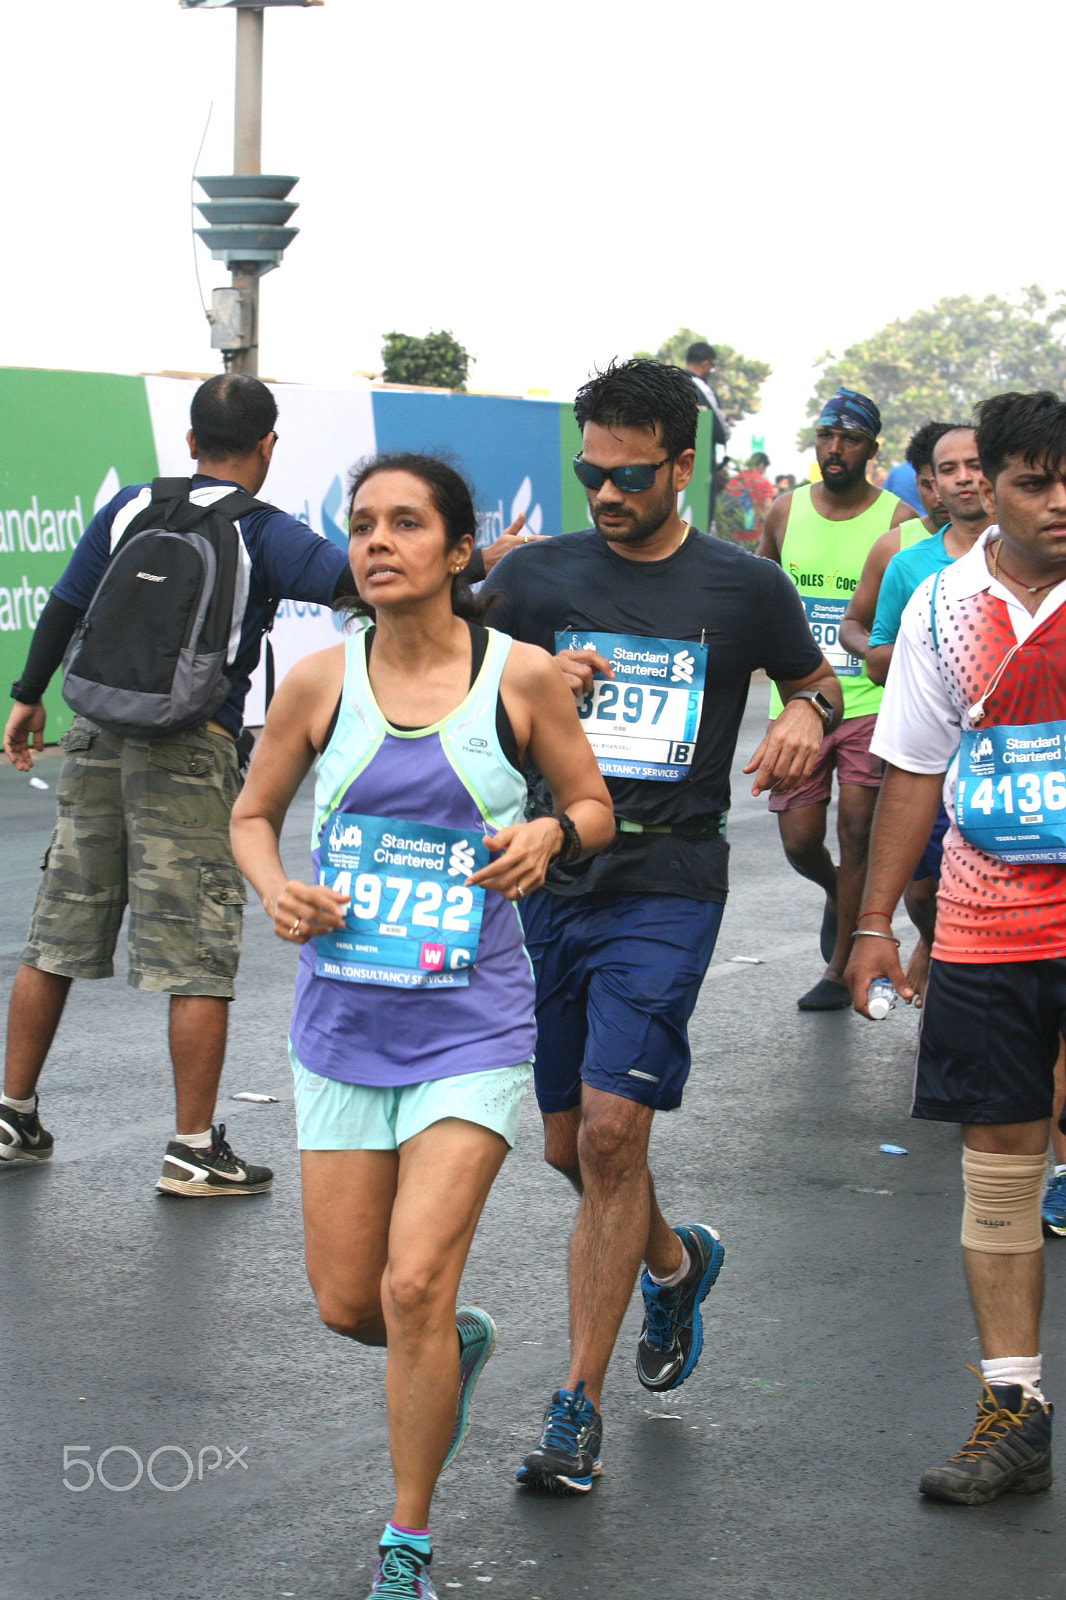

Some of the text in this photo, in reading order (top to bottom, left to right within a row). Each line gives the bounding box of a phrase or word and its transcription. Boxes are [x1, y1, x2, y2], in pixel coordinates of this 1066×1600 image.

[789, 568, 824, 587] SOLES
[836, 577, 859, 592] COC
[0, 575, 53, 631] arte
[813, 604, 845, 613] Standard
[613, 647, 669, 665] Standard
[851, 655, 859, 666] B
[609, 660, 668, 678] Chartered
[1006, 735, 1060, 750] Standard
[674, 744, 689, 763] B
[1002, 748, 1061, 764] Chartered
[642, 767, 679, 778] SERVICES
[381, 833, 446, 855] Standard
[373, 849, 444, 871] Chartered
[1001, 852, 1057, 862] CONSULTANCY
[424, 949, 441, 965] W
[450, 948, 471, 970] C
[324, 963, 454, 985] TATA CONSULTANCY SERVICES
